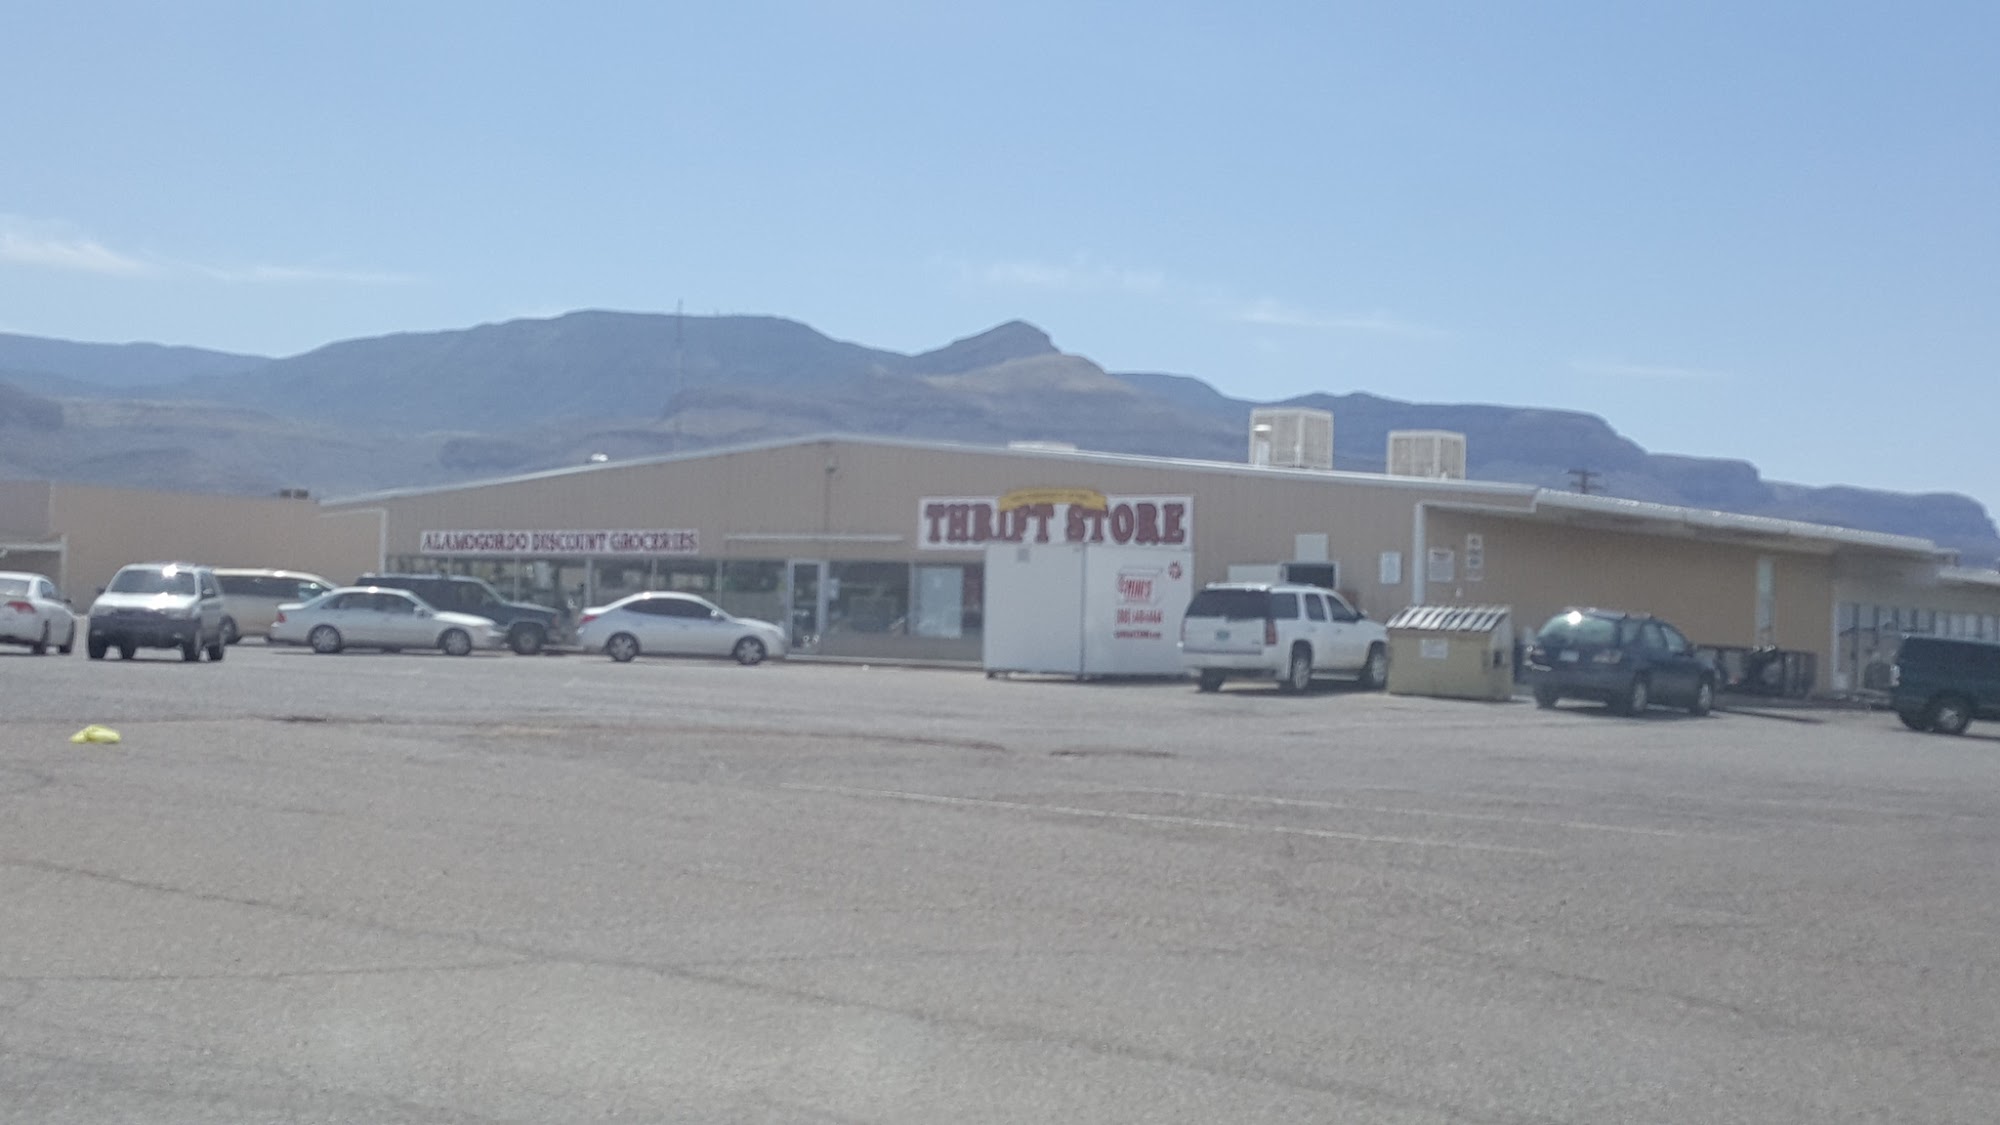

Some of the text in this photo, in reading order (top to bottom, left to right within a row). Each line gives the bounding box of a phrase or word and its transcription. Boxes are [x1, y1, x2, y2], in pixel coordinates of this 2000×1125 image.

[925, 502, 1185, 544] THRIFT STORE
[422, 533, 698, 550] ALAMOGORDO DISCOUNT GROCERIES
